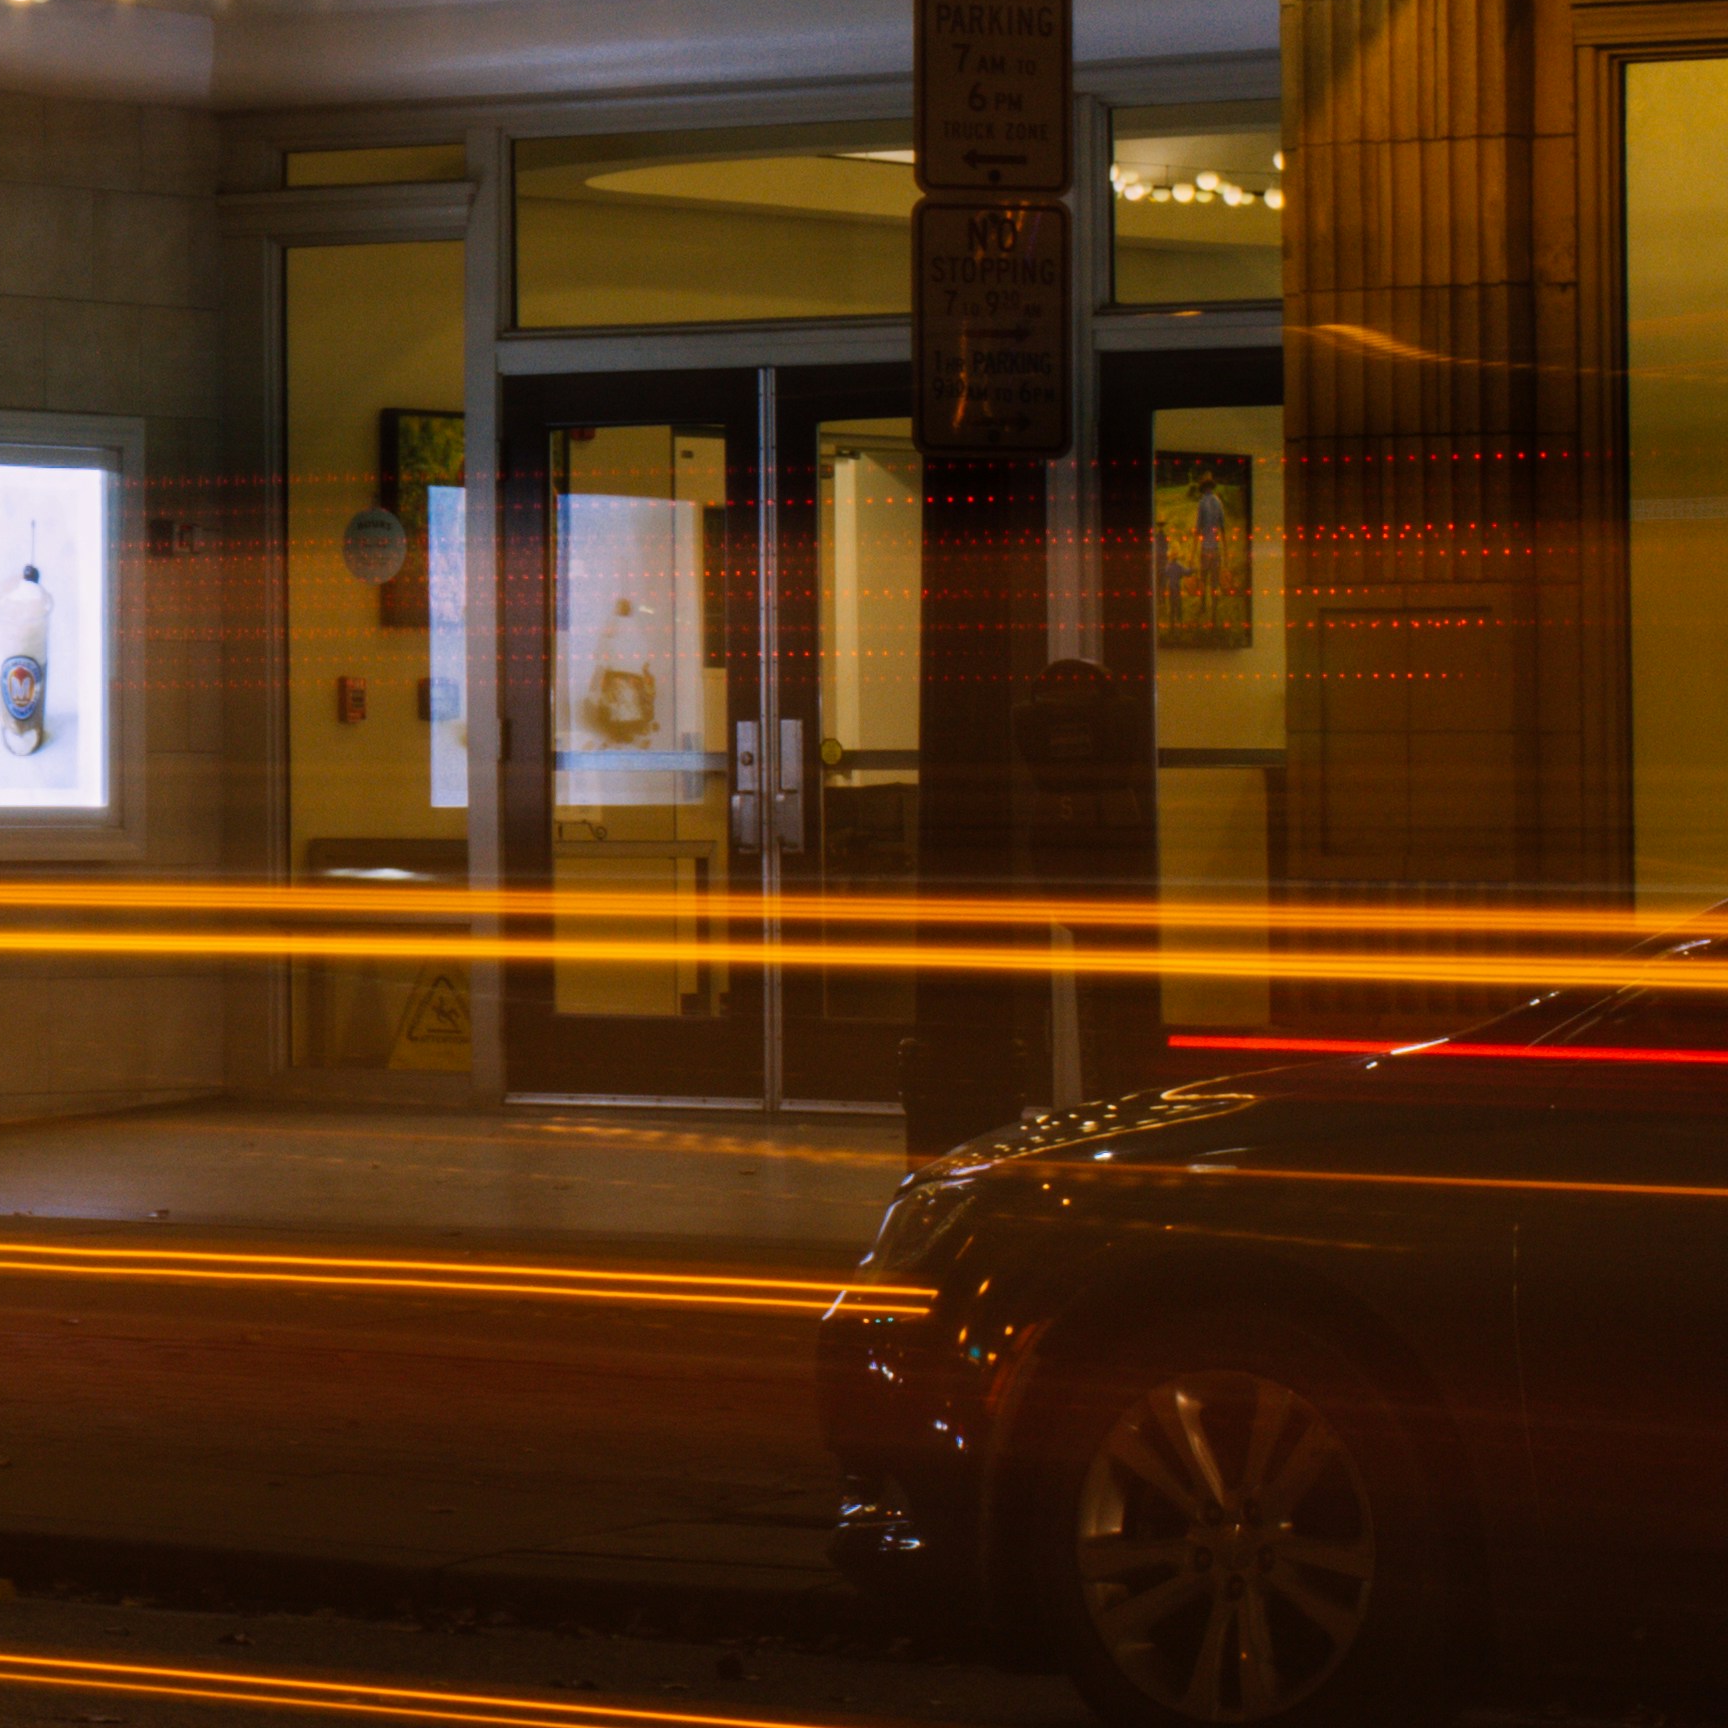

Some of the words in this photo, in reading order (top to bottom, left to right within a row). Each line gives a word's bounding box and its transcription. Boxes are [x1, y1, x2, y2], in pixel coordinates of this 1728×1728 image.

[937, 2, 1055, 38] PARKING
[952, 43, 971, 74] 7
[978, 56, 1005, 74] AM
[1016, 59, 1036, 76] TO
[968, 82, 987, 112] 6
[994, 93, 1023, 113] PM
[944, 121, 997, 142] TRUCK
[1006, 123, 1049, 143] ZONE
[966, 213, 1018, 253] NO
[930, 256, 1055, 286] STOPPING
[972, 349, 1052, 376] PARKING
